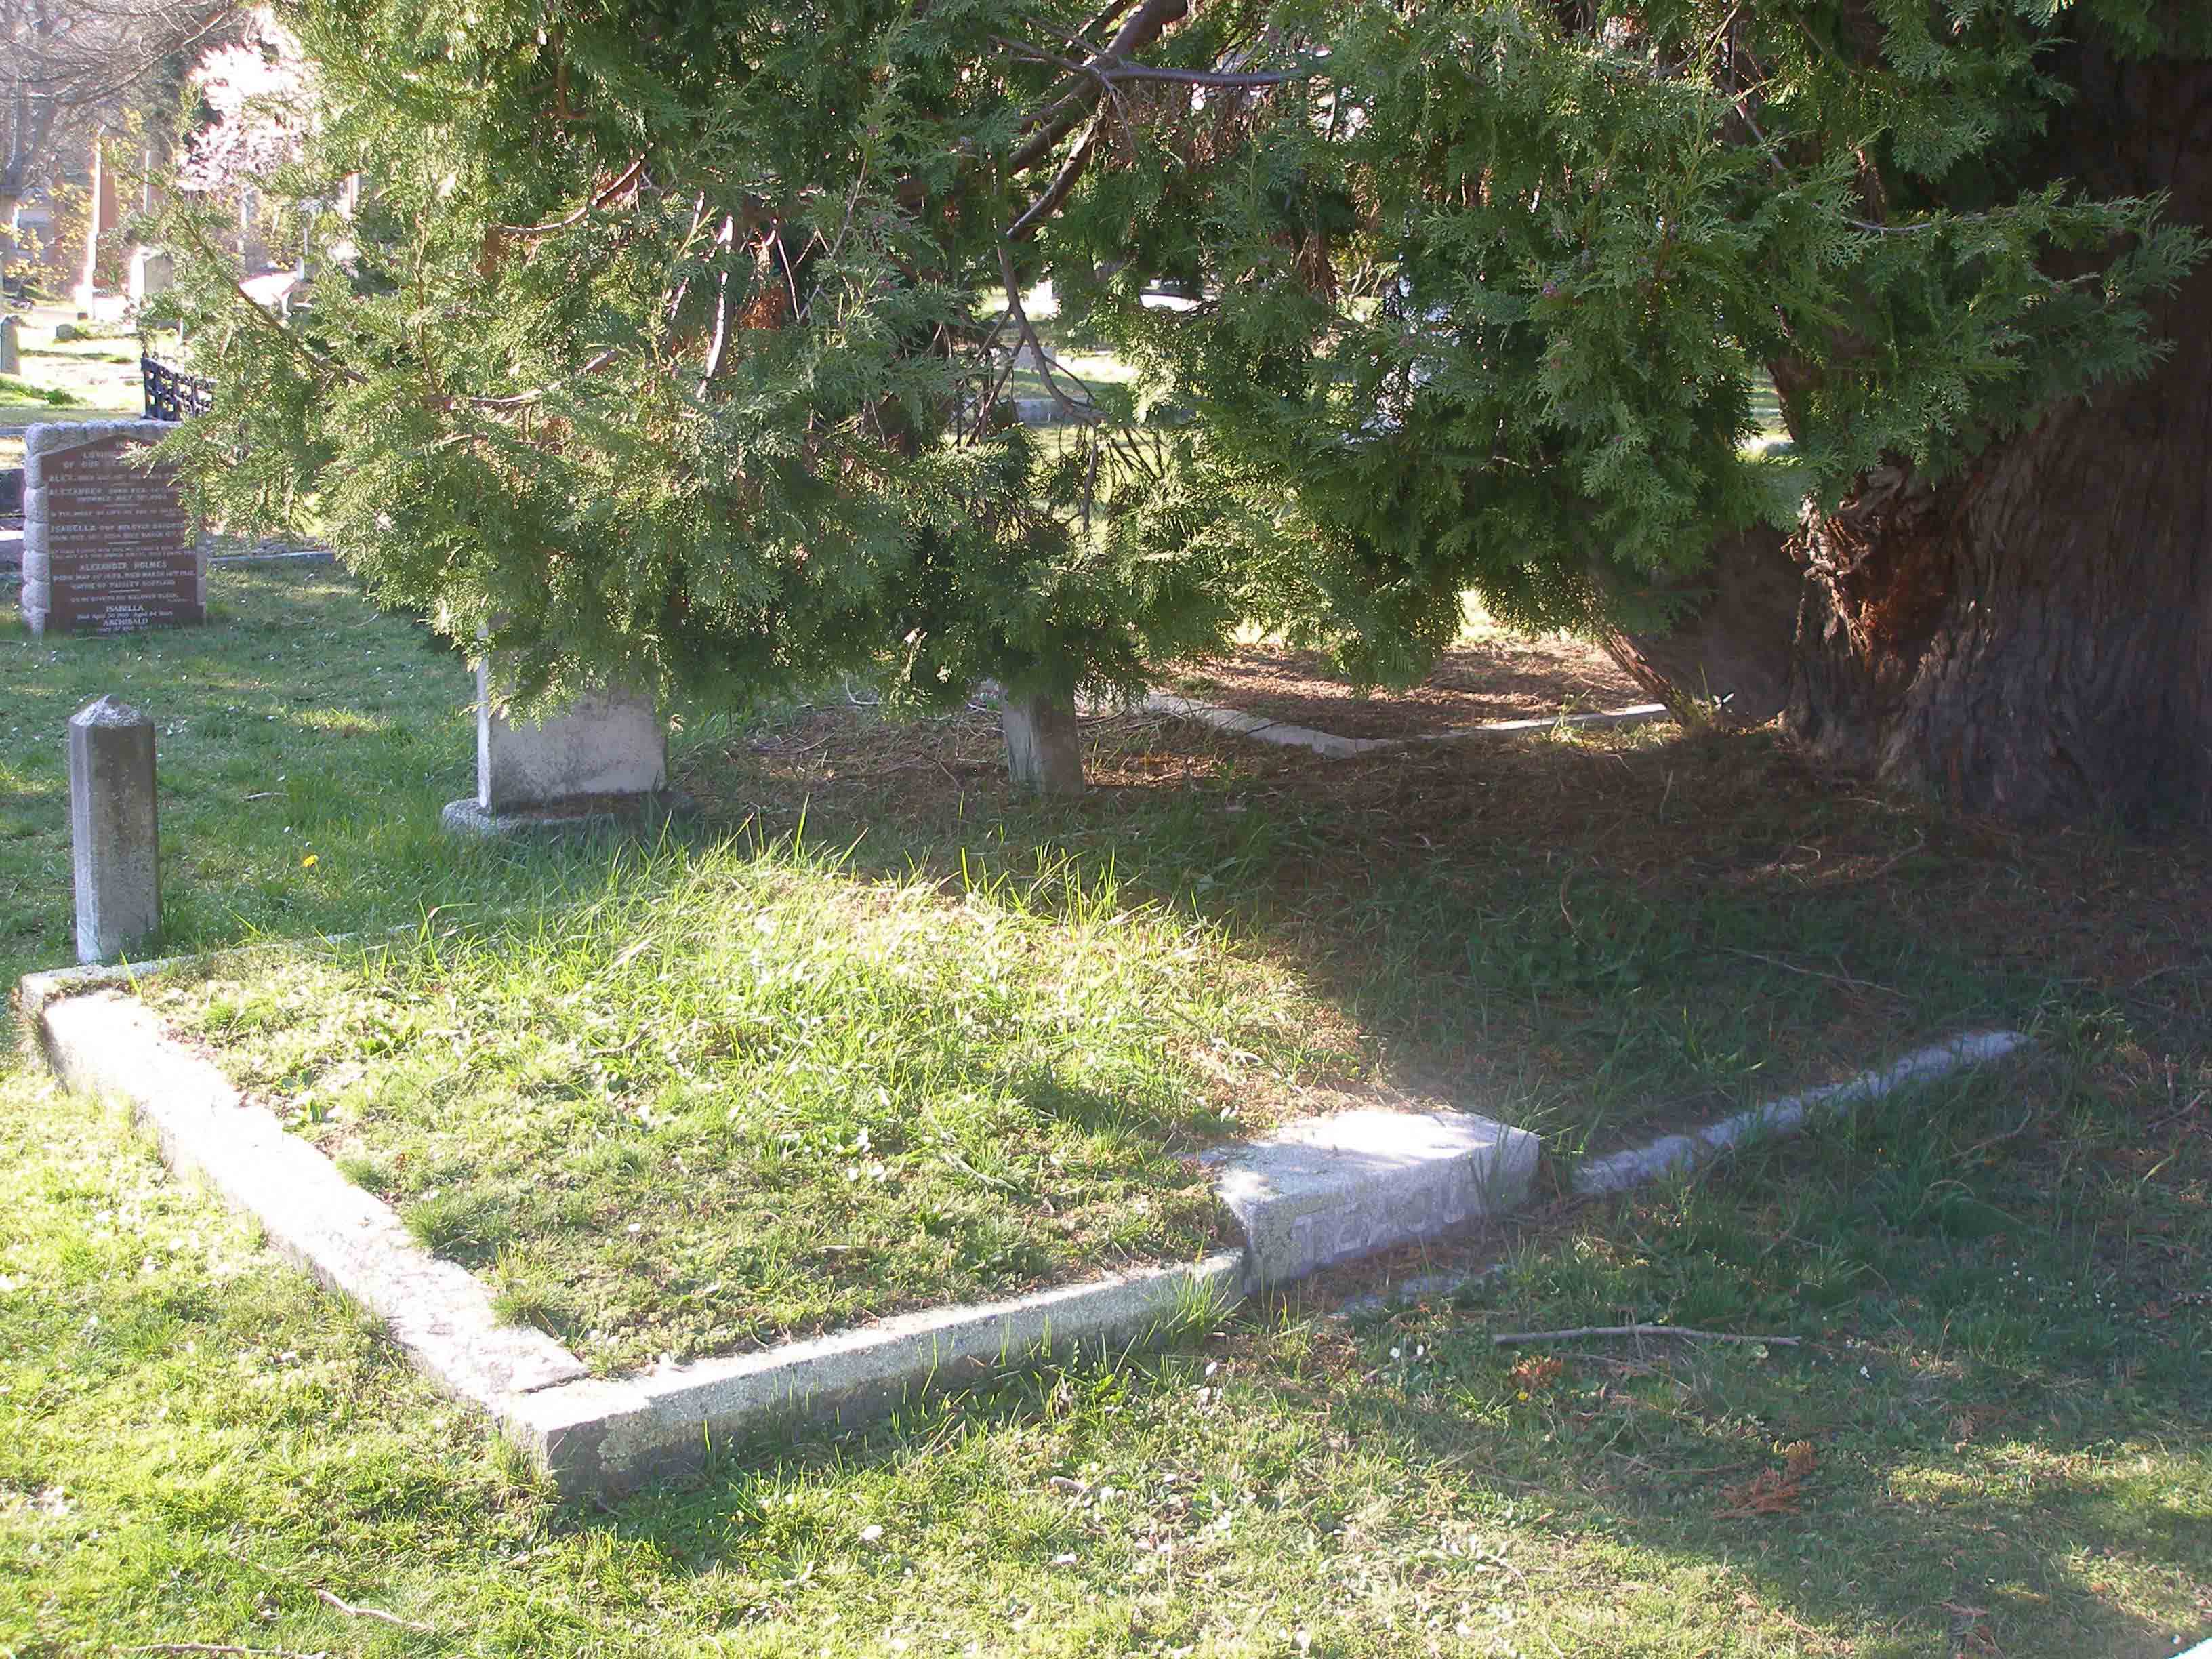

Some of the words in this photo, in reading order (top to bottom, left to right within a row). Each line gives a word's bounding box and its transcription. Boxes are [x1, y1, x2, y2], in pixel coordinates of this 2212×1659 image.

[50, 525, 97, 533] ISABELLA
[80, 562, 127, 571] ALEXANDER
[134, 560, 167, 569] HOLMES
[102, 617, 149, 627] ARCHIBALD
